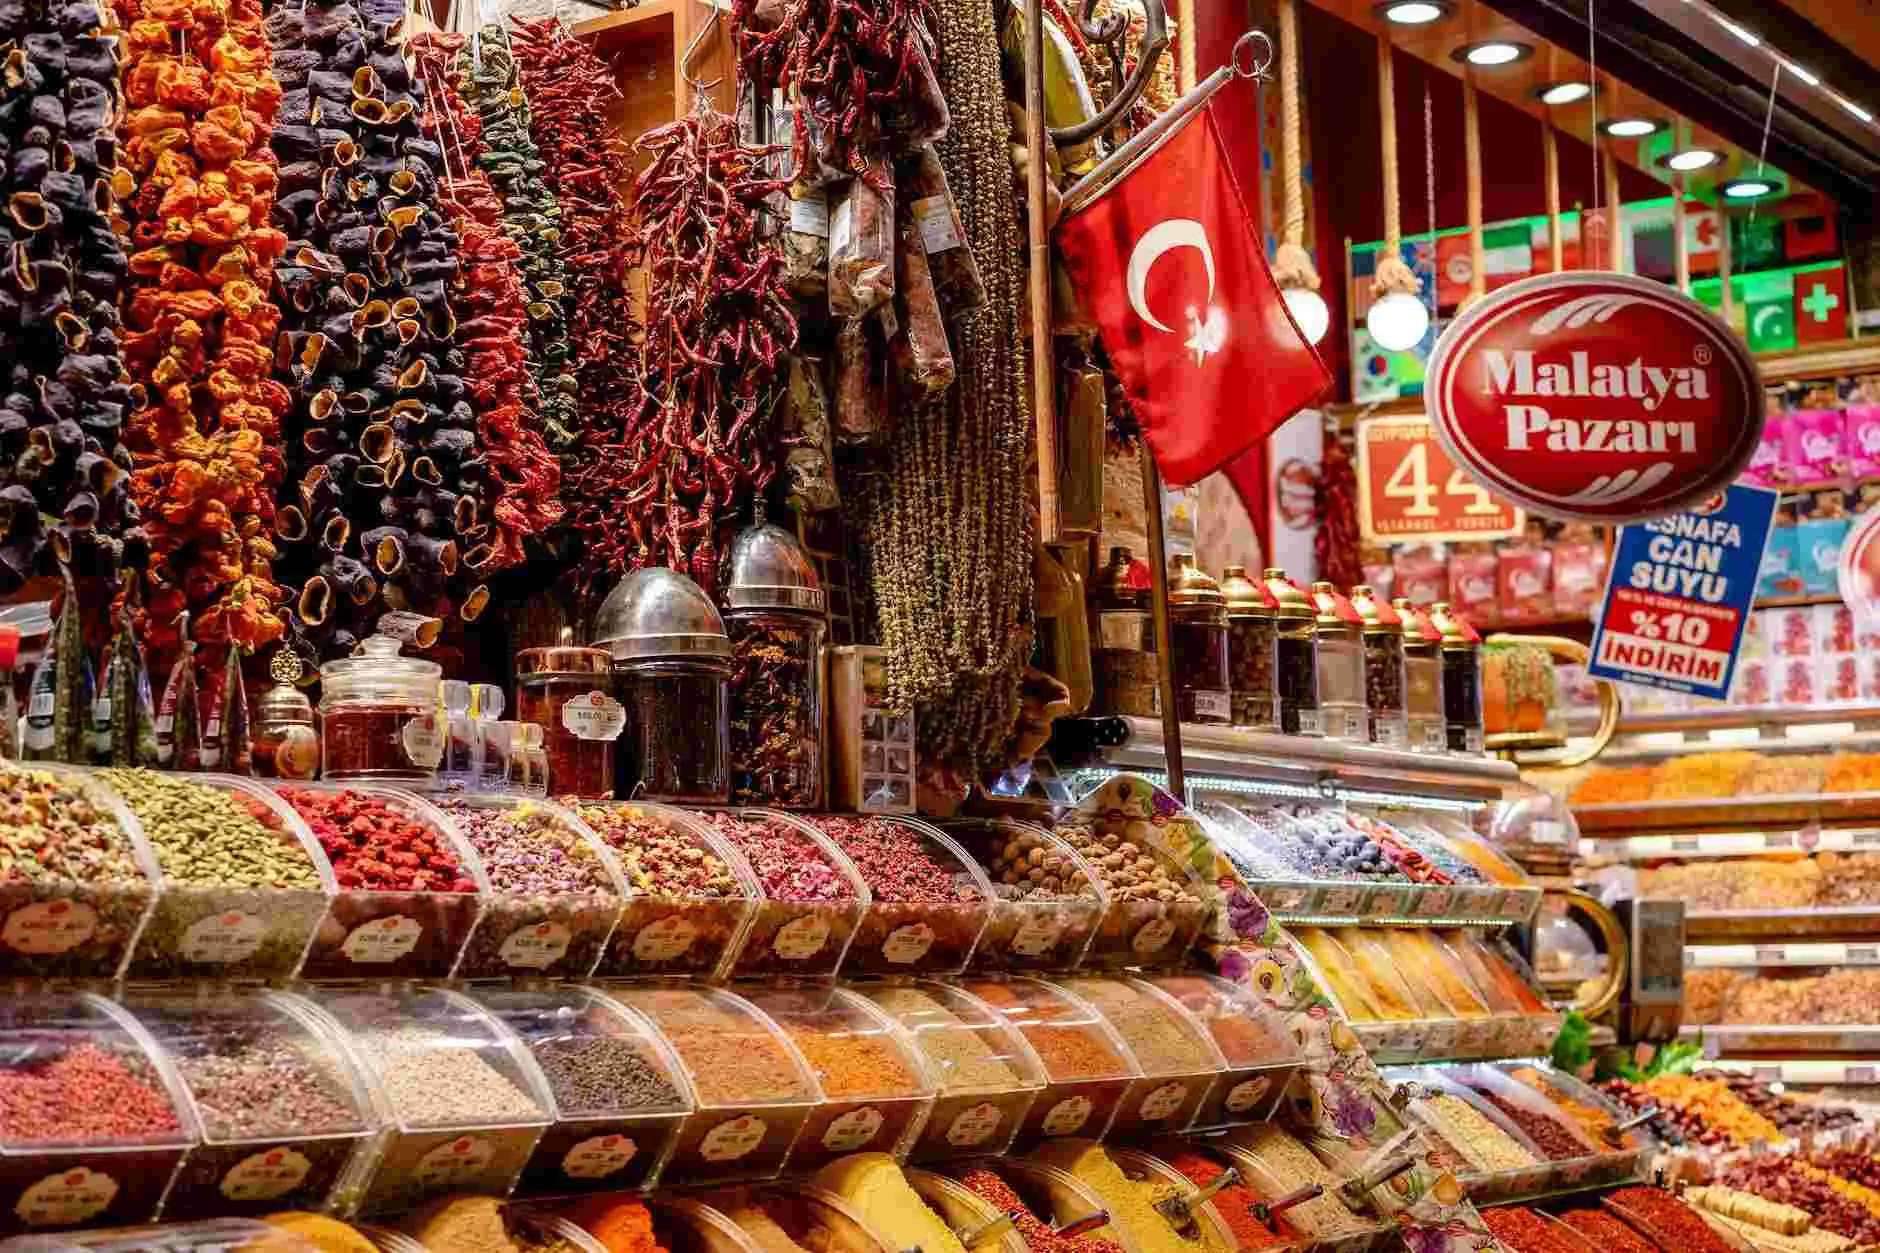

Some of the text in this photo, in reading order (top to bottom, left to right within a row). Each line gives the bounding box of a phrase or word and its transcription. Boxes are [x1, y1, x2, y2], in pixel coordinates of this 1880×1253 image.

[1481, 350, 1710, 411] Malatya
[1503, 404, 1696, 452] Pazarı
[1384, 443, 1500, 516] 44
[1649, 535, 1723, 573] CAN
[1630, 561, 1728, 602] SUYU
[1630, 610, 1710, 646] %10
[1604, 636, 1721, 681] İNDİRİM
